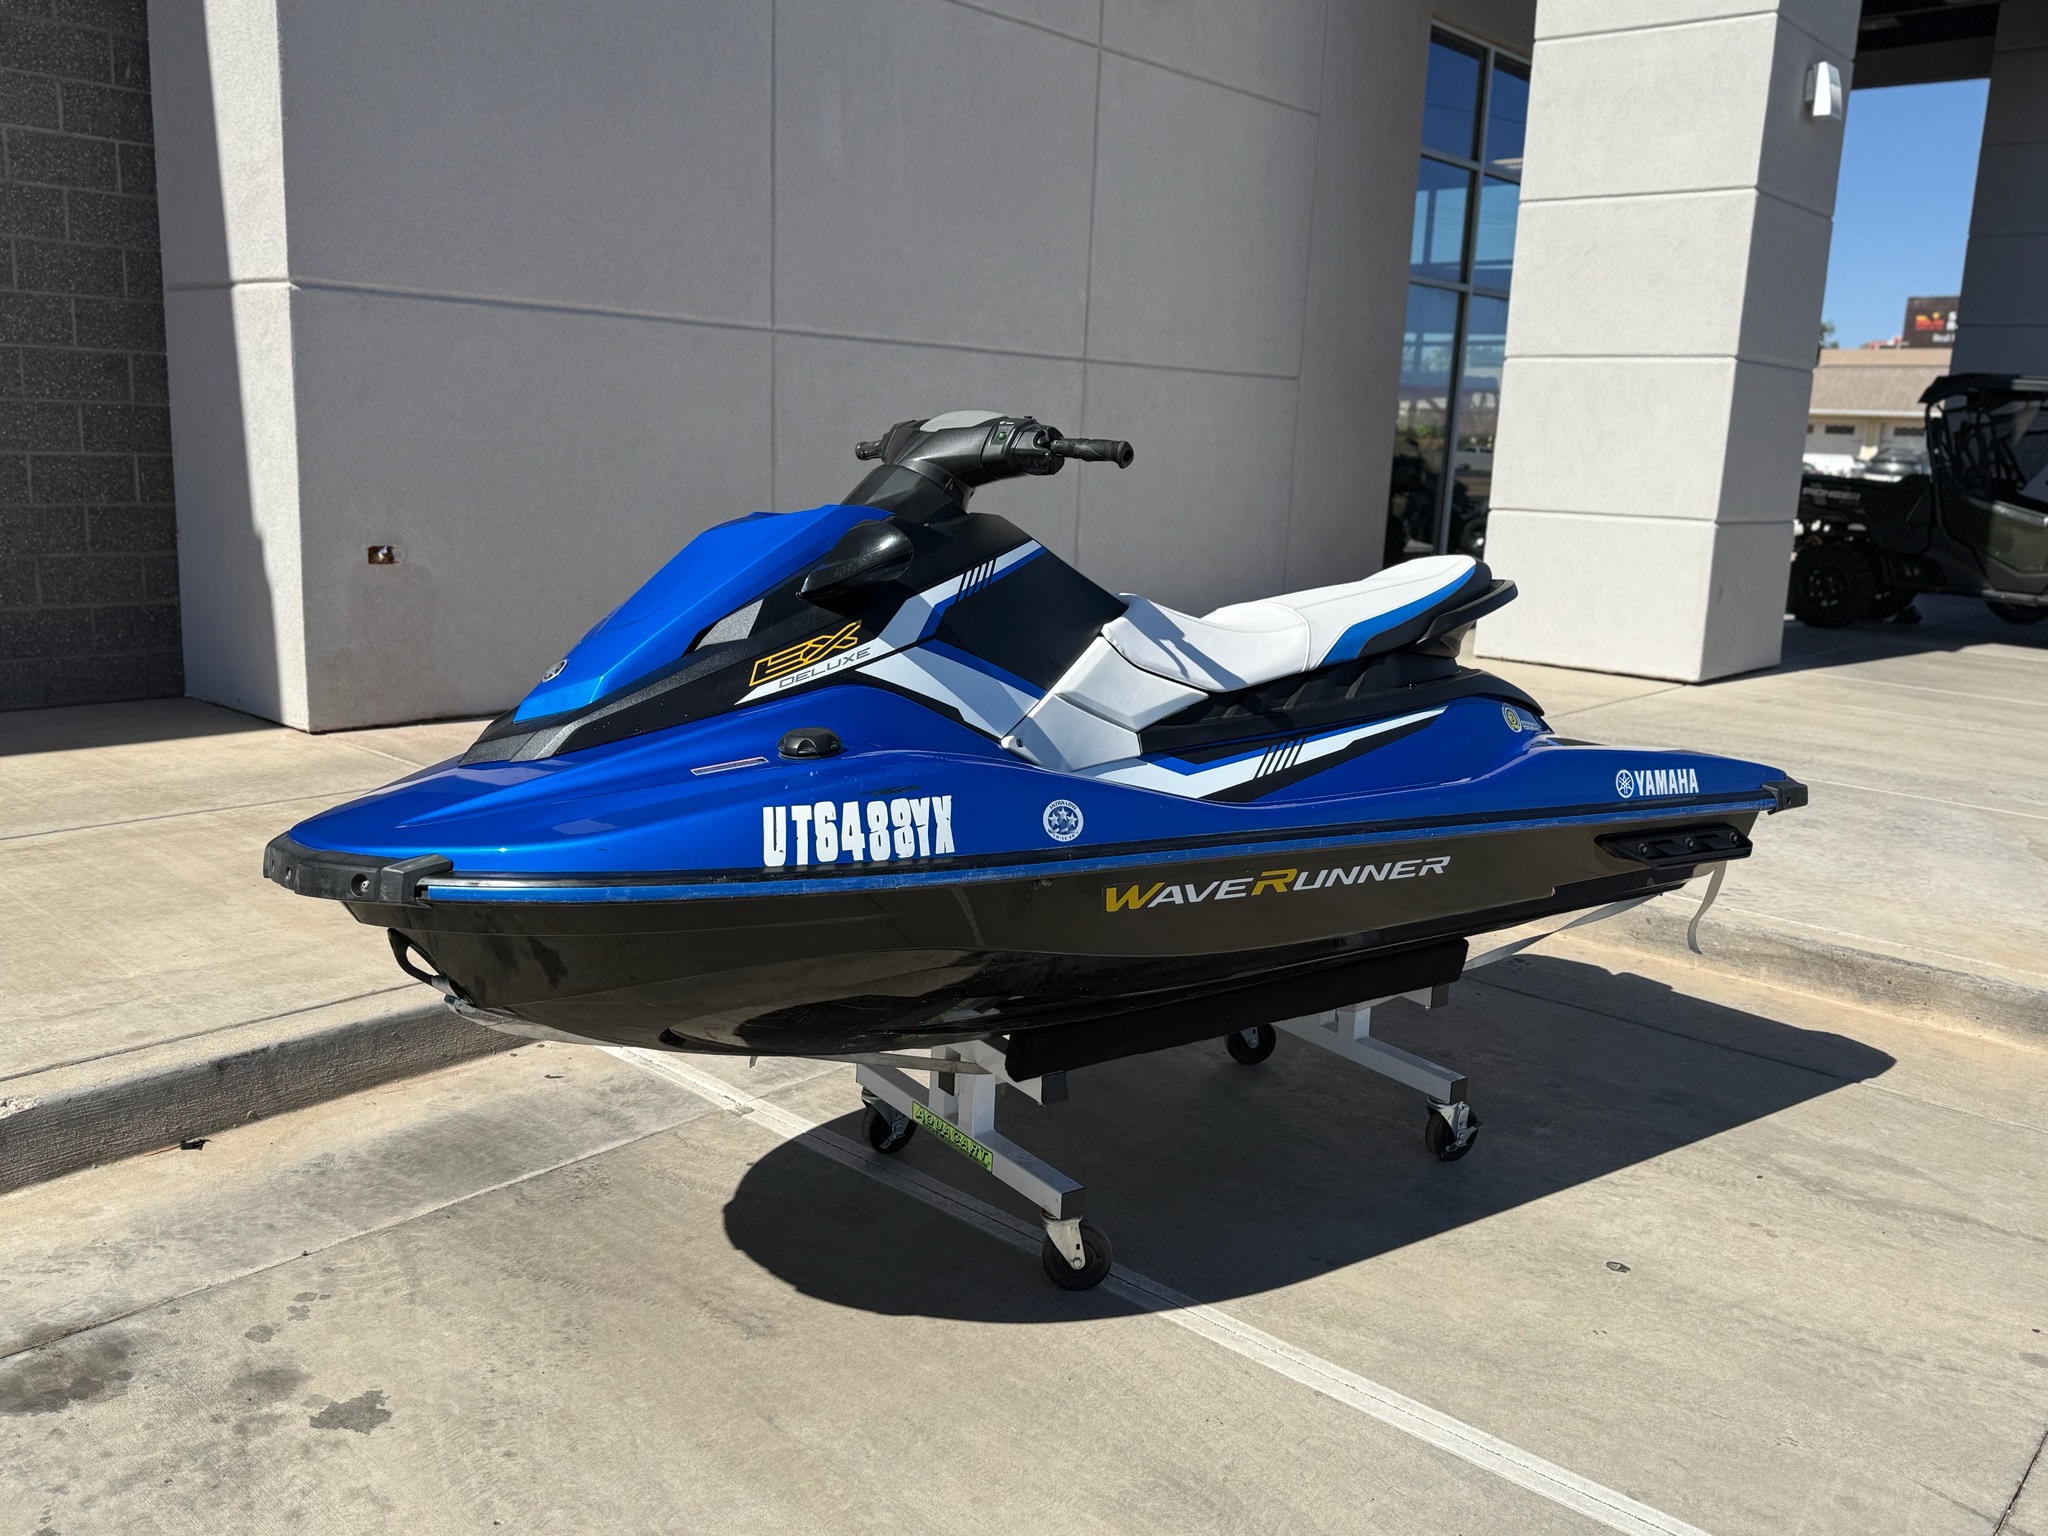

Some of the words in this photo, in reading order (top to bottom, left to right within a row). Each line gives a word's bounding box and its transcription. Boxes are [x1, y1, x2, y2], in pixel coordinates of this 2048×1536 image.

[749, 619, 862, 686] EX
[778, 647, 871, 689] DELUXE
[1049, 801, 1065, 809] ULTRA
[1633, 768, 1700, 796] YAMAHA
[763, 795, 956, 867] UT6488YX
[1105, 855, 1451, 913] WAVERUNNER
[915, 1108, 989, 1162] AQUACART
